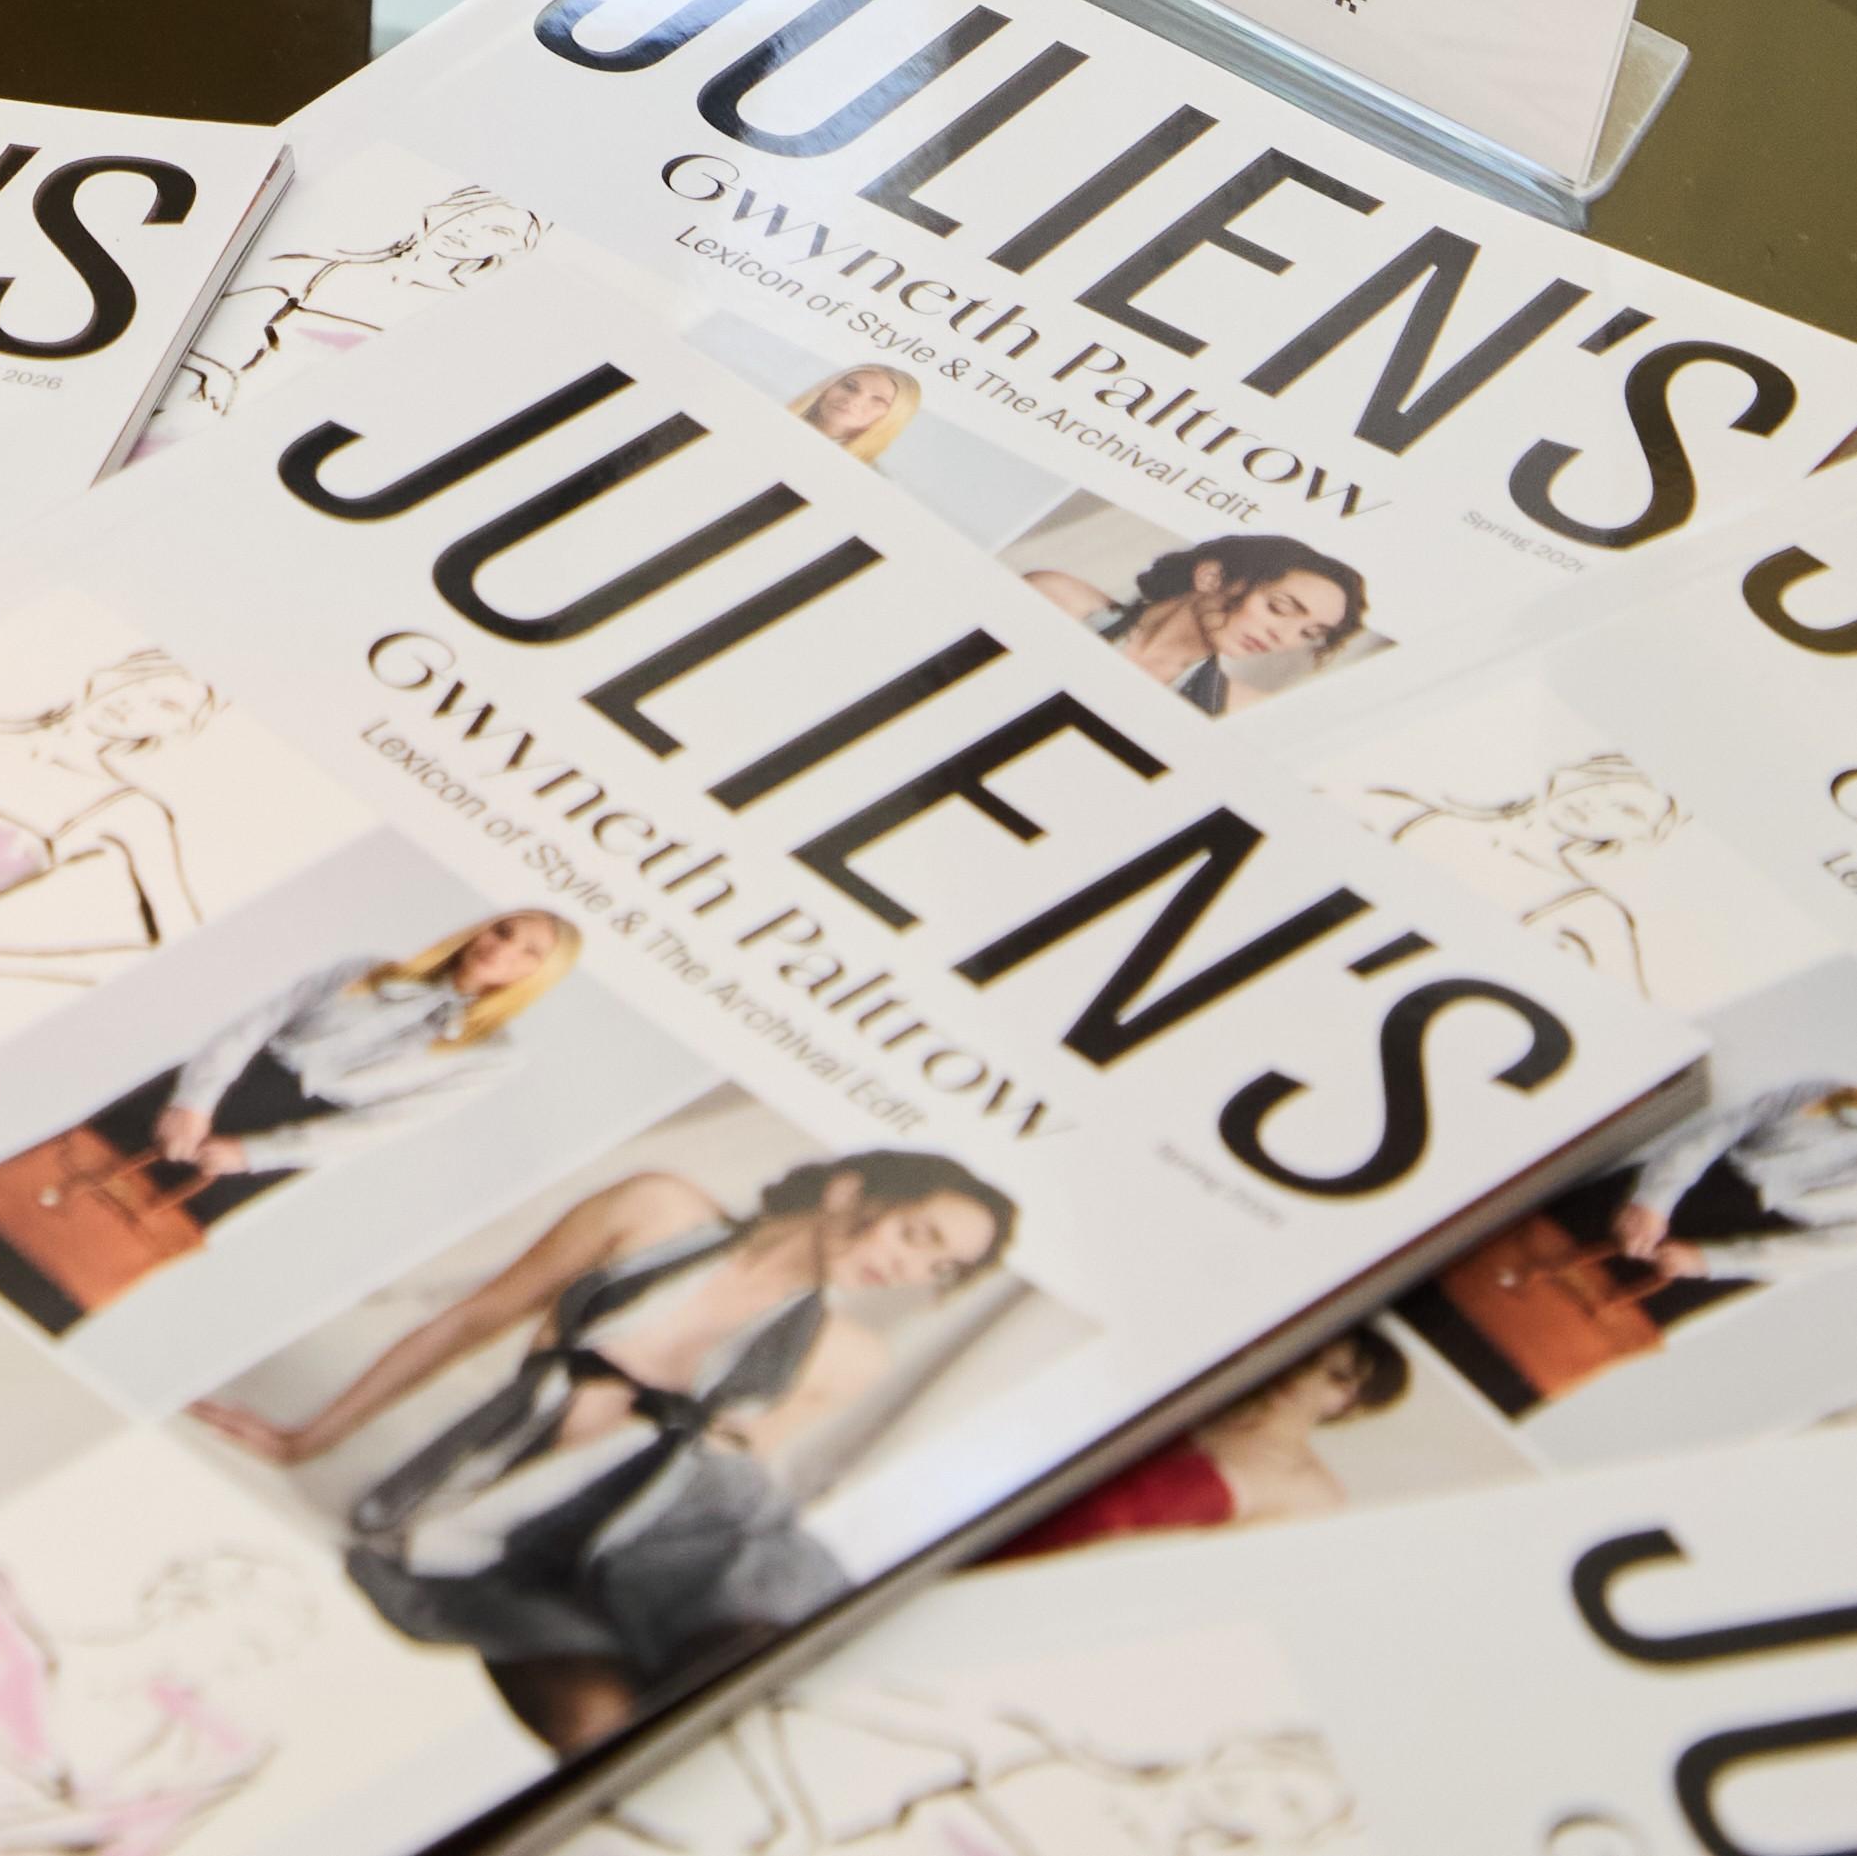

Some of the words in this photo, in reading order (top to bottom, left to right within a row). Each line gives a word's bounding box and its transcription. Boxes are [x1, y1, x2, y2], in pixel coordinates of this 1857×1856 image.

[1, 367, 65, 392] 2026
[661, 153, 1042, 361] Gwyneth
[1050, 342, 1393, 520] Paltrow
[674, 225, 804, 300] Lexicon
[805, 294, 853, 320] of
[847, 310, 937, 366] Style
[939, 356, 972, 382] &
[972, 369, 1039, 415] The
[1036, 407, 1188, 488] Archival
[1183, 475, 1264, 525] Edit
[276, 360, 1576, 1204] JULIEN'S
[360, 718, 489, 820] Lexicon
[484, 815, 533, 848] of
[522, 840, 617, 915] Style
[645, 927, 712, 985] The
[367, 630, 737, 918] Gwyneth
[735, 906, 1081, 1140] Paltrow
